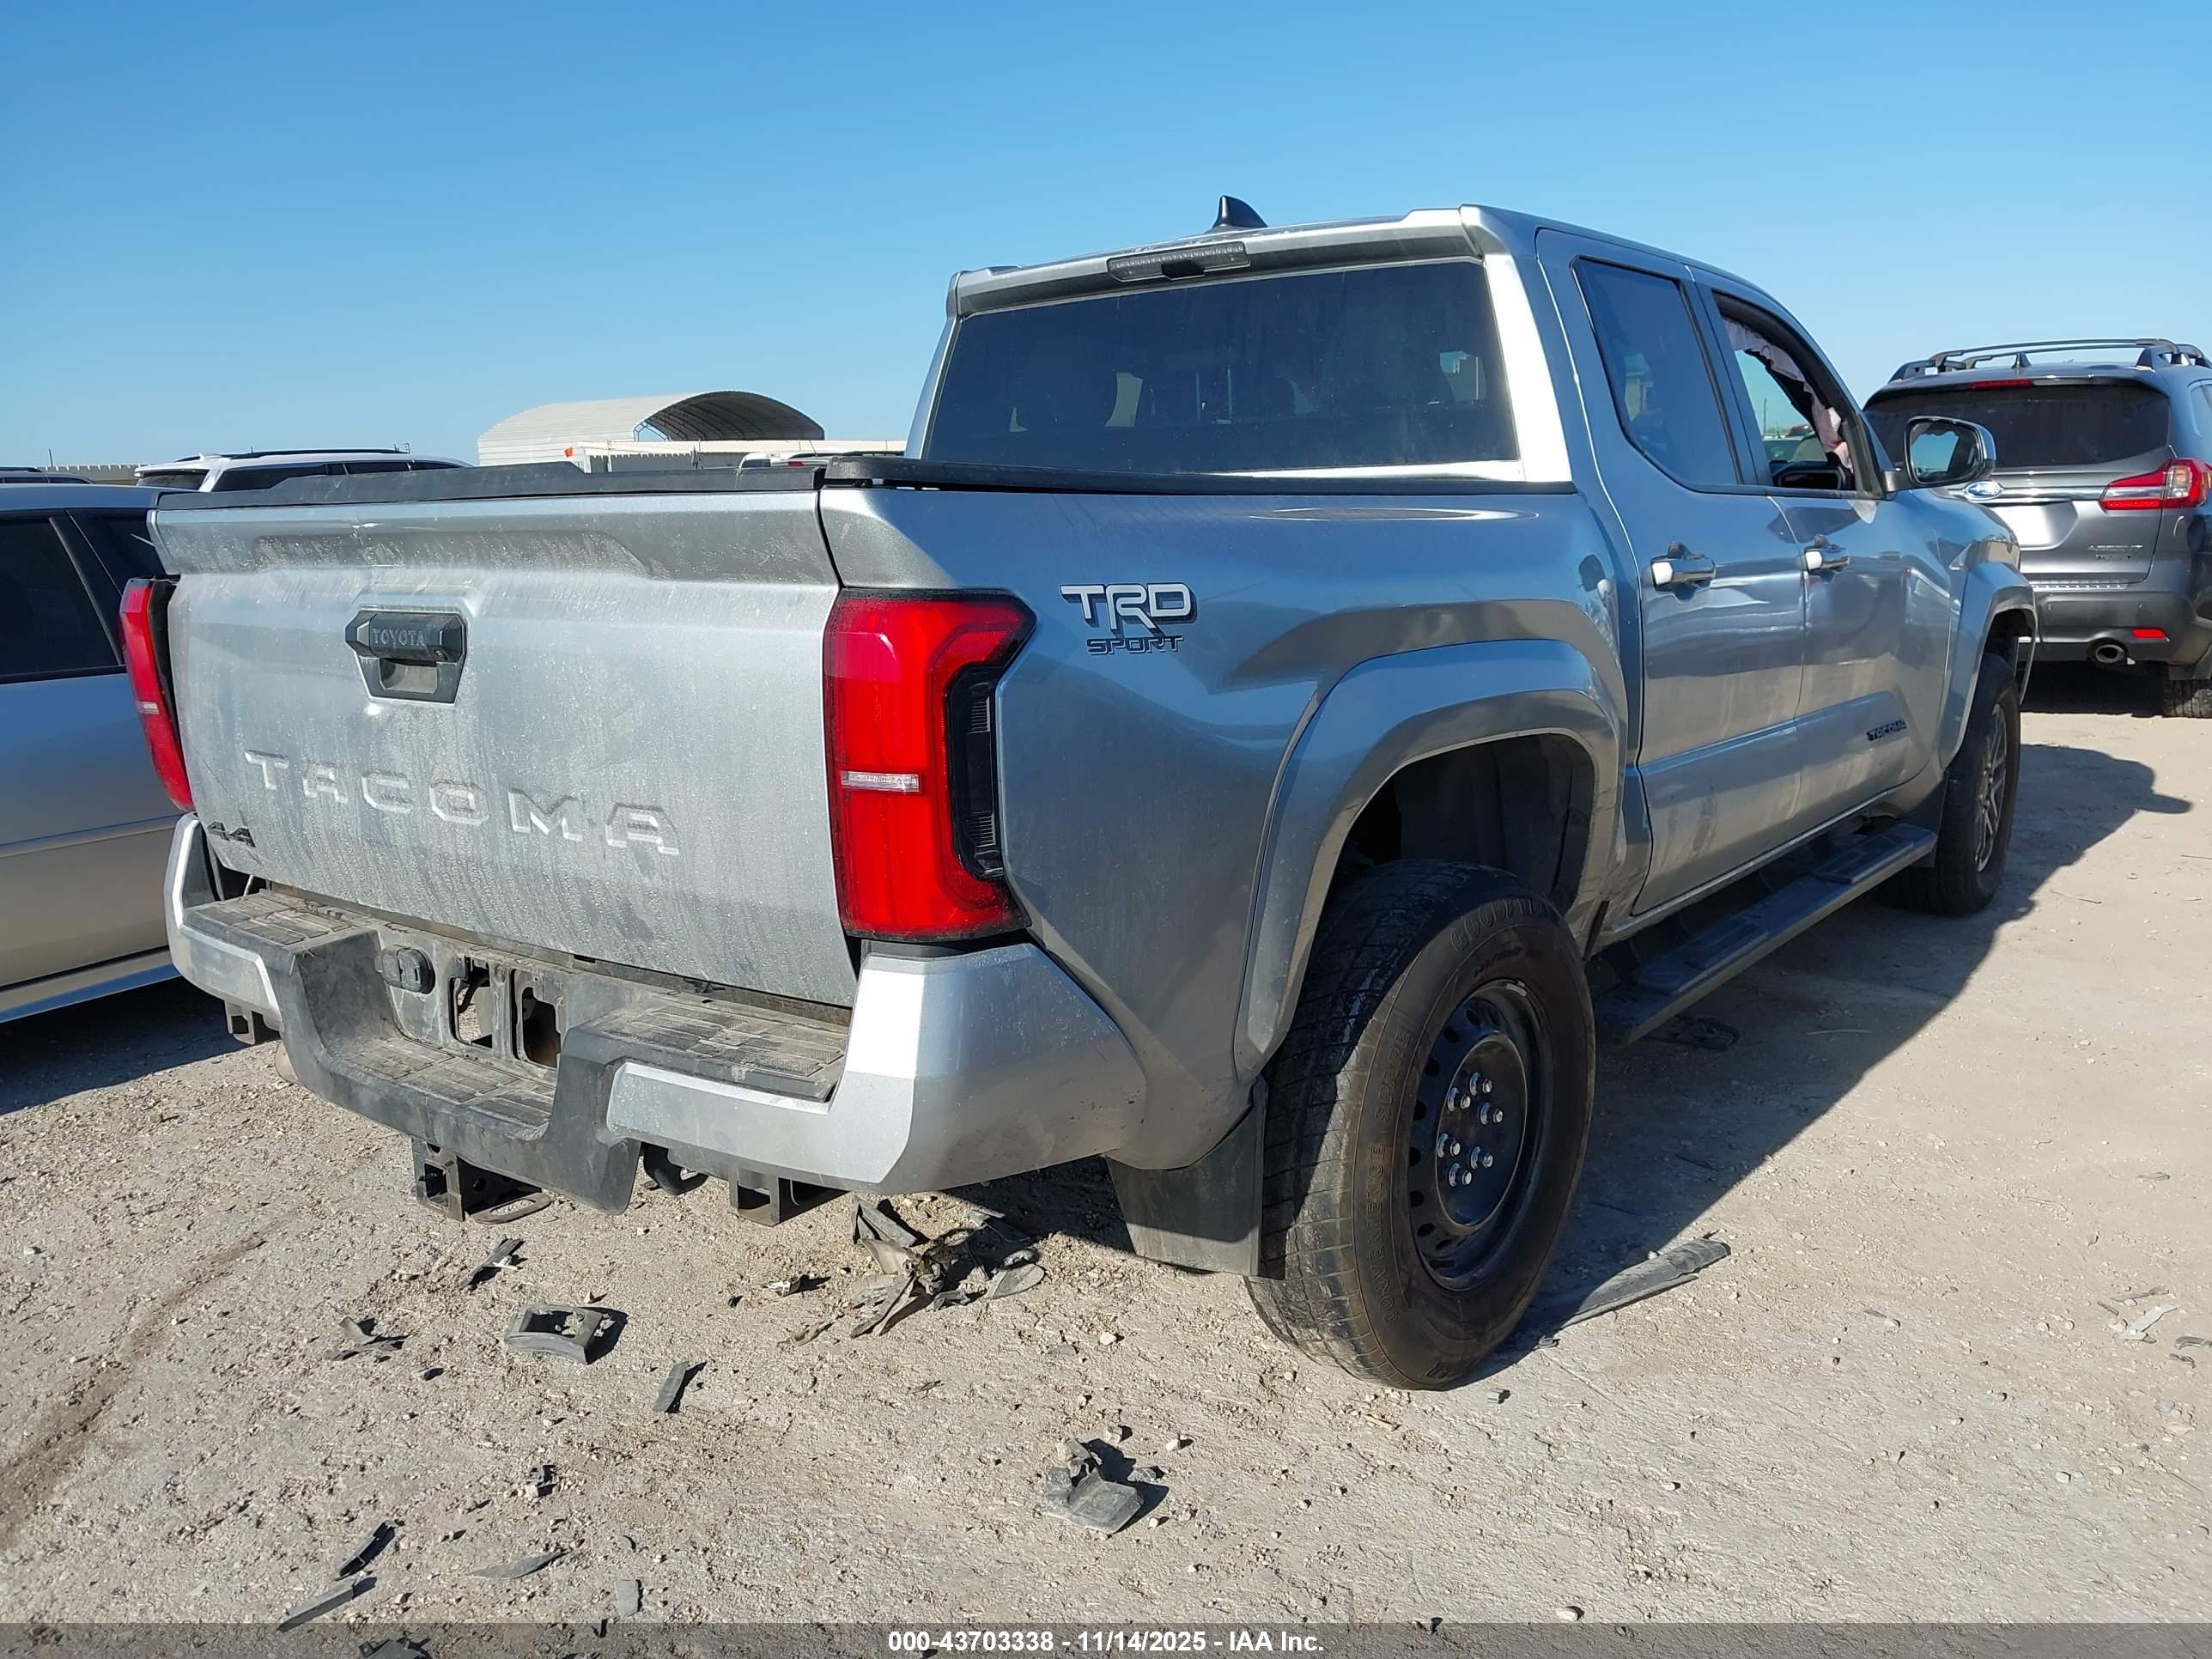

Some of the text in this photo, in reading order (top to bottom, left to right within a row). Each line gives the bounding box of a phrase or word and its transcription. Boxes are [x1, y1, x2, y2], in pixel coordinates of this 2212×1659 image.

[372, 628, 426, 647] TOYOTA
[1060, 583, 1197, 638] TRD
[1087, 635, 1184, 655] SPORT
[245, 749, 680, 856] TACOMA
[1449, 897, 1559, 952] GOODYE
[1374, 1030, 1411, 1121] SPARE
